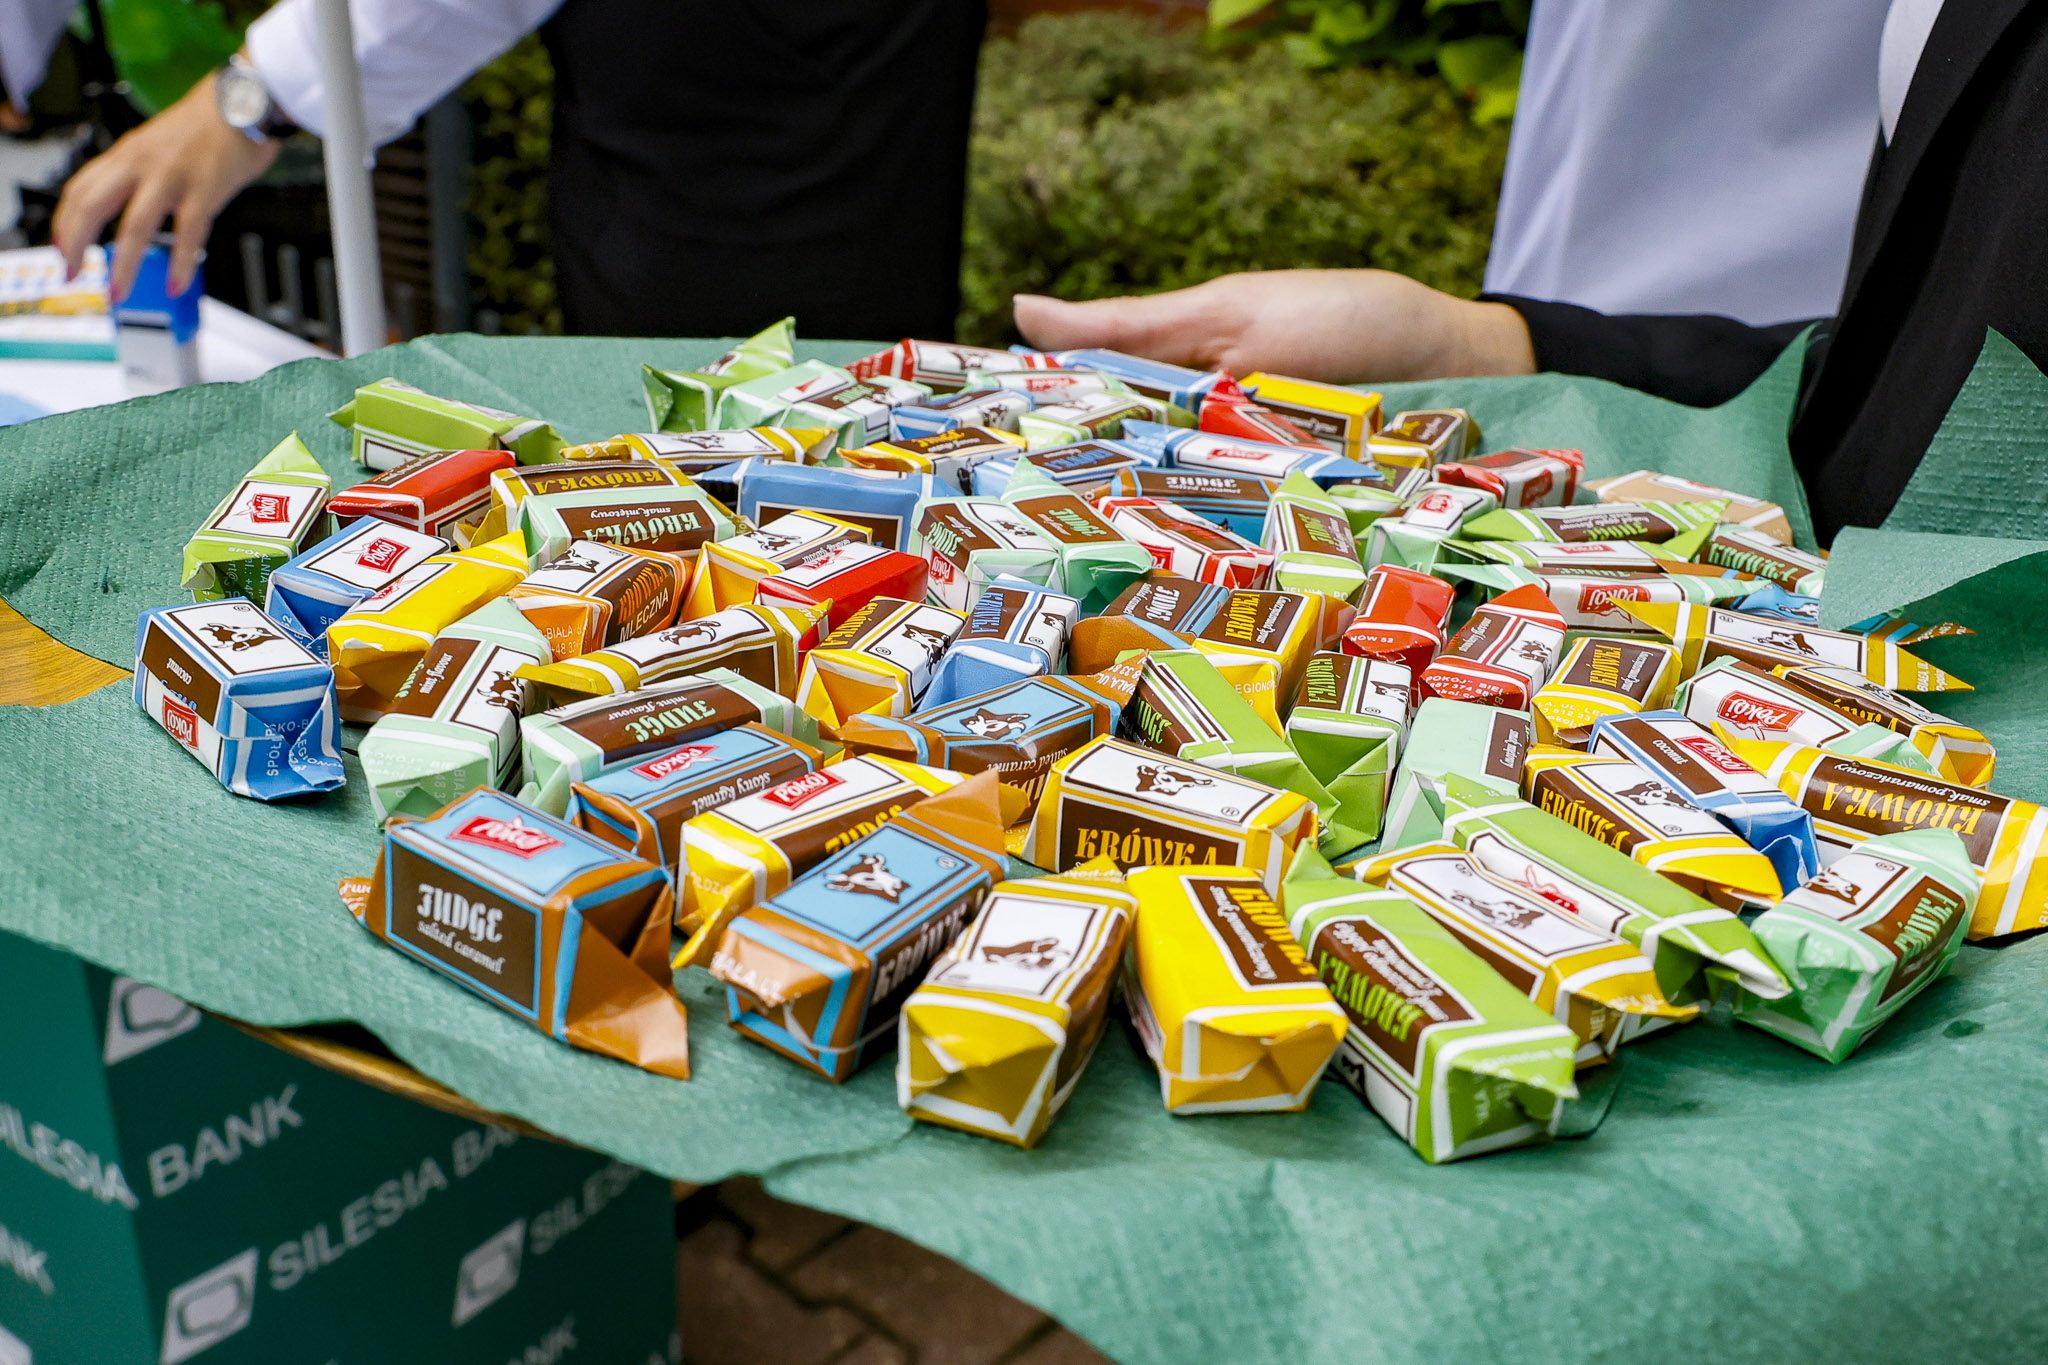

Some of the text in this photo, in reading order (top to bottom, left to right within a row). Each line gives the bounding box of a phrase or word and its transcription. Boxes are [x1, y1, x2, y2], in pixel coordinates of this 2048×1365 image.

[531, 470, 665, 495] KRÓWKA
[1165, 475, 1237, 488] FUDGE
[256, 496, 280, 520] Pokój
[590, 507, 672, 520] smak miętowy
[583, 512, 702, 546] KRÓWKA
[926, 521, 964, 558] FUDGE
[364, 540, 398, 567] Pokój
[929, 556, 951, 580] Pokój
[617, 560, 669, 626] KRÓWKA
[1146, 585, 1180, 622] FUDGE
[619, 587, 670, 643] MLECZNA
[819, 601, 879, 648] KRÓWKA
[971, 591, 1007, 634] KRÓWKA
[1223, 592, 1261, 641] KRÓWKA
[1265, 595, 1293, 633] pomarańczowy
[166, 657, 193, 686] coconut
[419, 652, 455, 695] mint flavour
[1306, 656, 1342, 705] KRÓWKA
[1586, 643, 1623, 688] KRÓWKA
[168, 708, 193, 740] Pokój
[608, 694, 688, 722] mint flavour
[625, 699, 717, 743] FUDGE
[1728, 698, 1788, 726] Pokój
[649, 745, 702, 778] Pokój
[1652, 738, 1689, 766] coconut
[691, 771, 771, 816] słony karmel
[774, 768, 830, 803] Pokój
[1833, 762, 1950, 796] pomarańczowy
[1949, 787, 1991, 808] smak
[1821, 781, 1987, 836] KRÓWKA
[1075, 826, 1218, 869] KRÓWKA
[416, 882, 504, 943] FUDGE
[1893, 887, 1960, 956] KRÓWKA
[416, 919, 506, 976] salted caramel
[1317, 950, 1426, 1042] KRÓWKA
[148, 1083, 304, 1198] BANK
[268, 1155, 449, 1292] SILESIA
